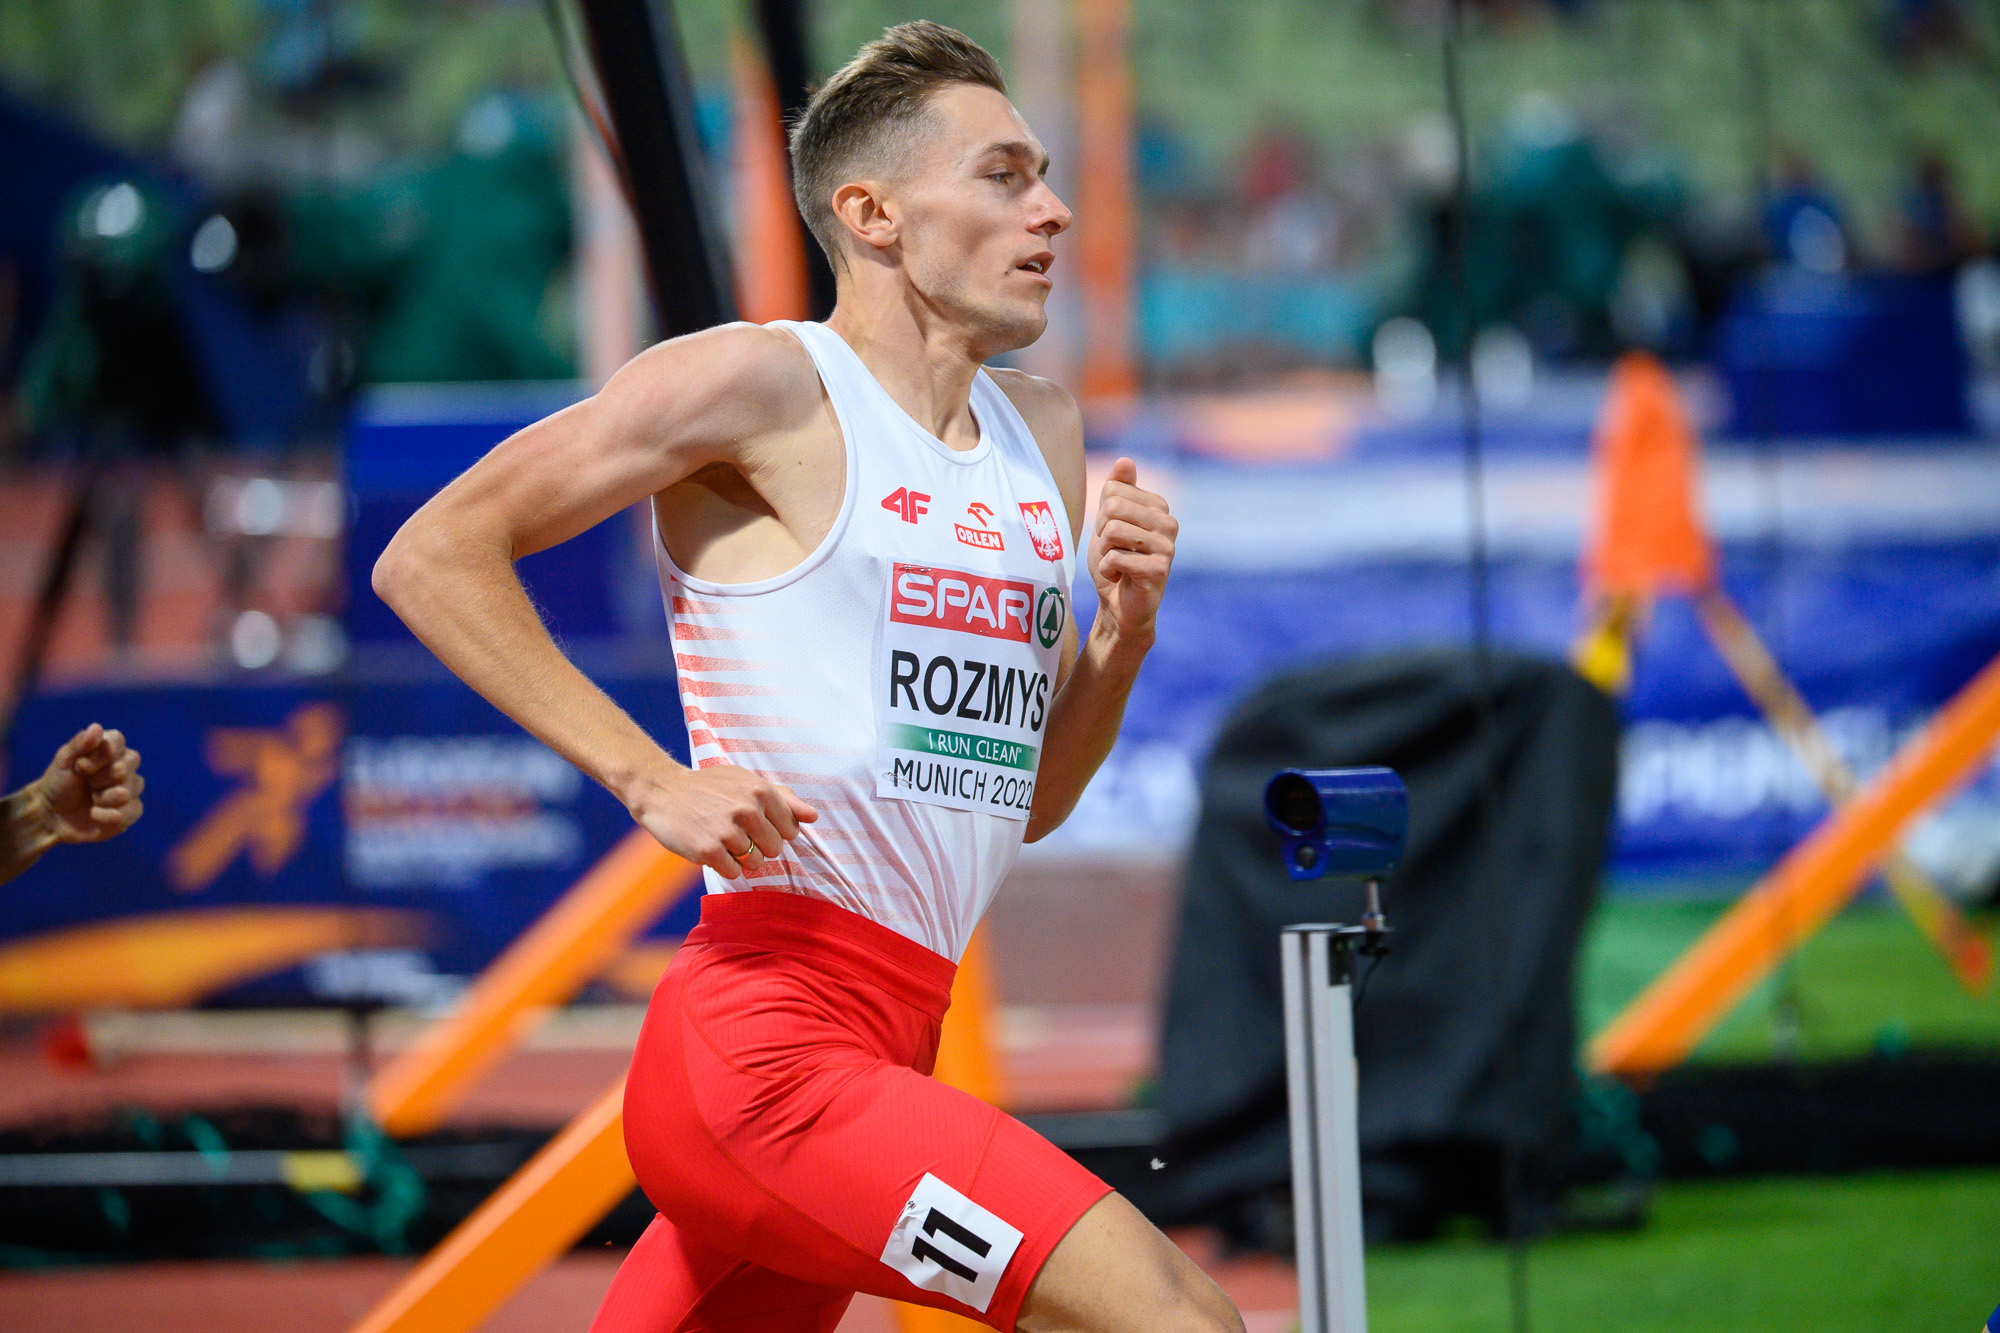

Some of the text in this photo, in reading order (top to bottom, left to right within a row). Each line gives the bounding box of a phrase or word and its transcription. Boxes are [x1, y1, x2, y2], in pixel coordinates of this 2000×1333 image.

[881, 486, 931, 524] 4F
[957, 527, 1001, 548] ORLEN
[896, 572, 1031, 634] SPAR
[890, 649, 1048, 732] ROZMYS
[928, 732, 934, 750] I
[938, 733, 970, 756] RUN
[893, 758, 1033, 811] MUNICH 2022
[911, 1206, 993, 1284] 11
